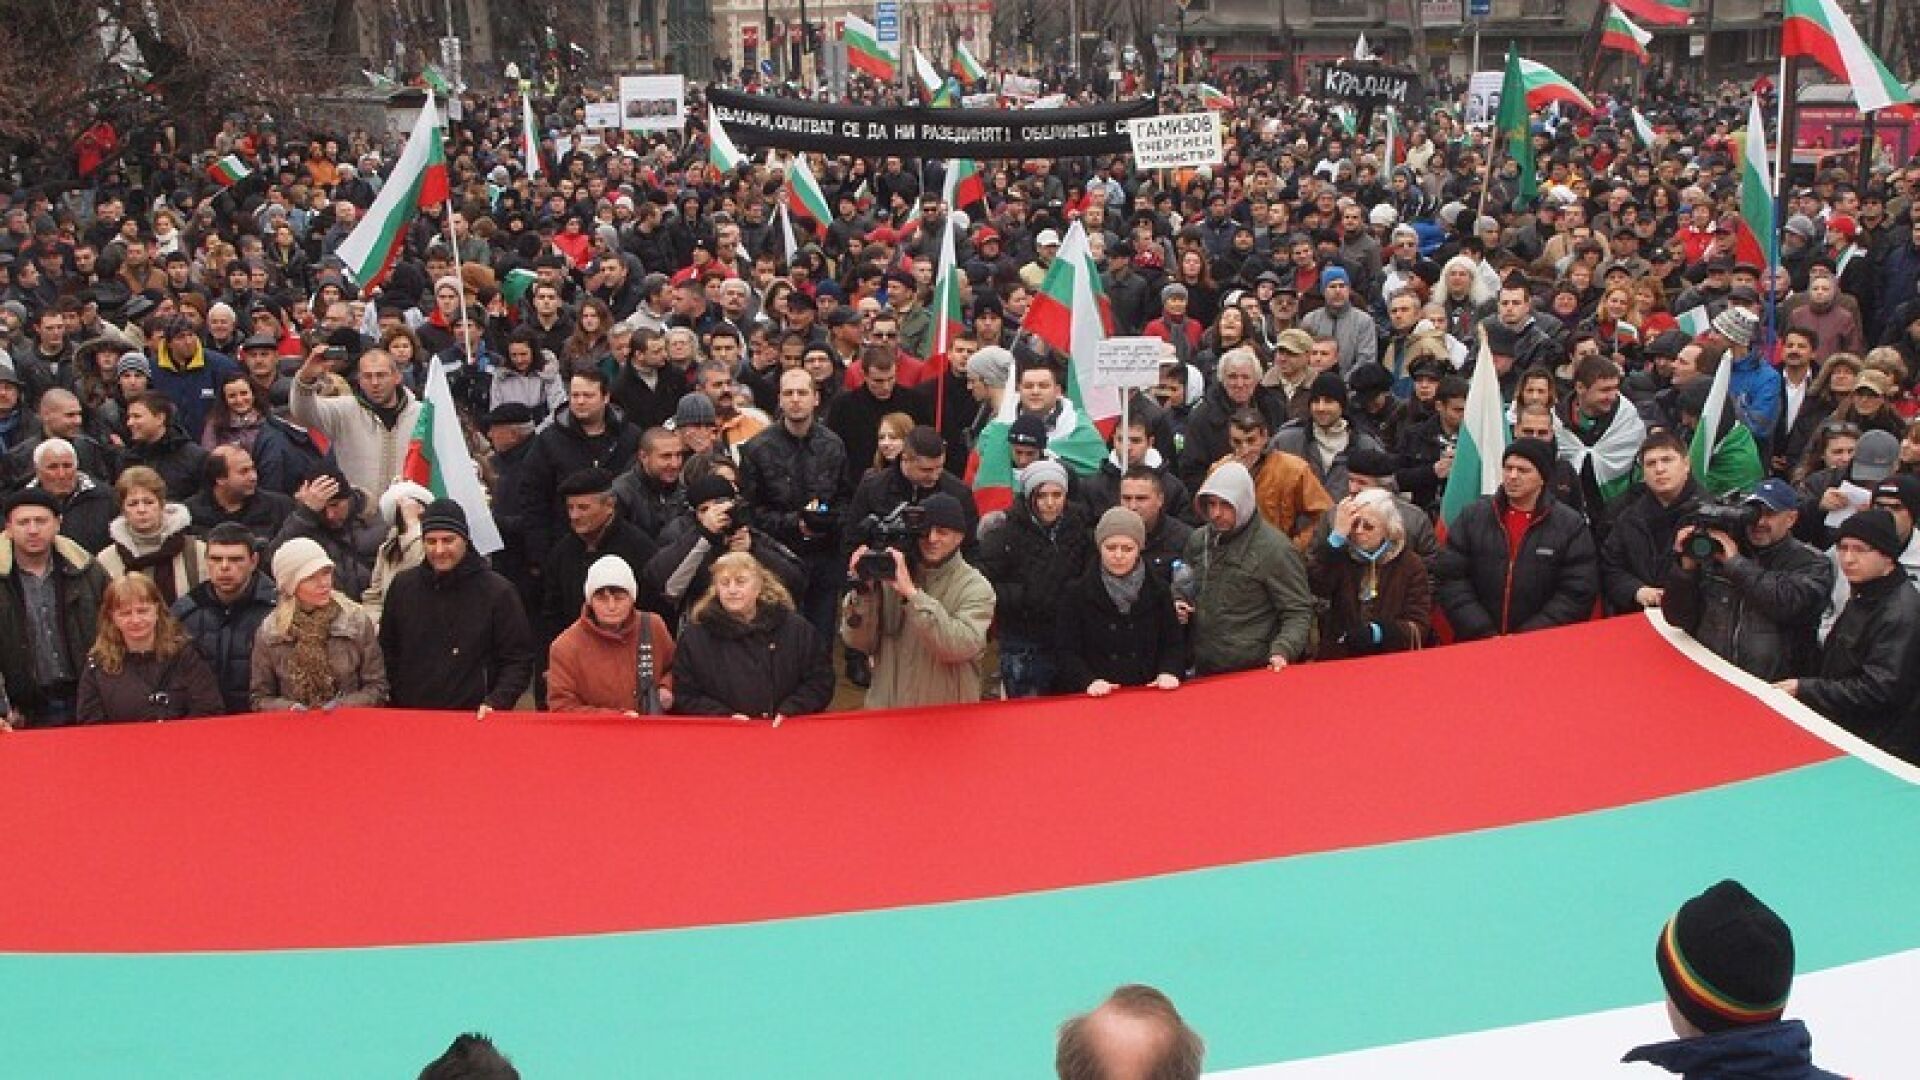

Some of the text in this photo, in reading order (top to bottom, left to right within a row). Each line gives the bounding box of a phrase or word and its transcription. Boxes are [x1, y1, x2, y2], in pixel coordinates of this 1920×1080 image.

[842, 121, 860, 138] СЕ
[866, 122, 889, 140] ДА
[894, 124, 915, 140] НИ
[1137, 114, 1213, 138] ГАМИЗОВ
